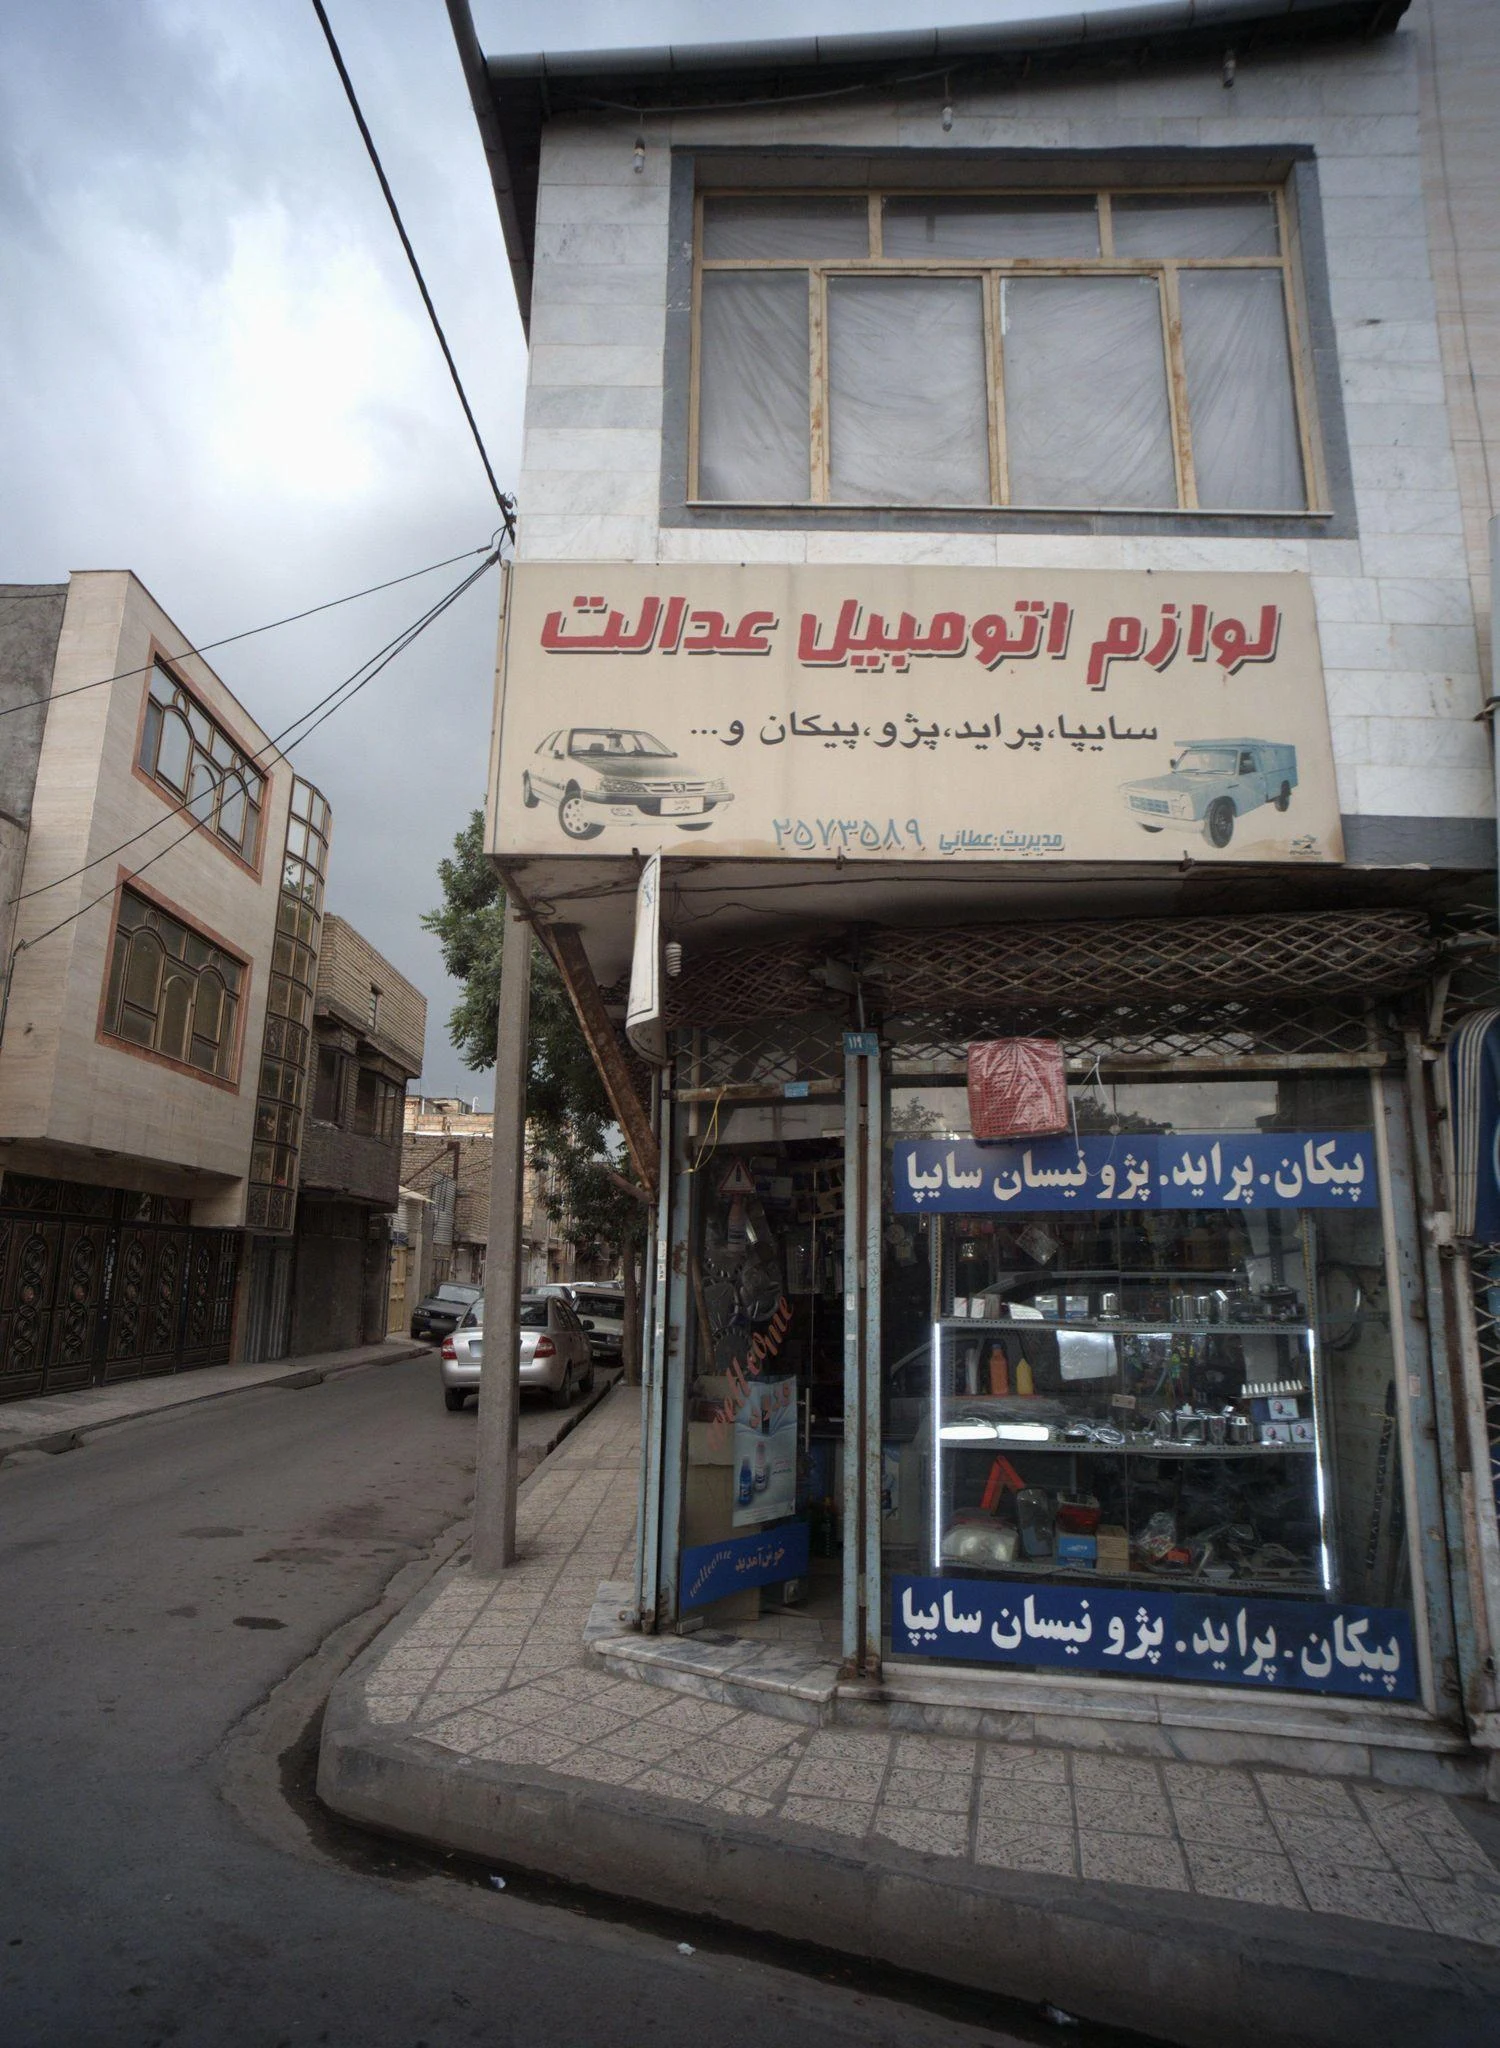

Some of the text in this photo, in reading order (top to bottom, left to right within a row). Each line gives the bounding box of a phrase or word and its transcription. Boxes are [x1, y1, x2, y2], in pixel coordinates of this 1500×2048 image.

[540, 595, 1282, 692] لوازم اتومبیل عدالت
[772, 818, 925, 851] ۲۵۷۳۵۸۹
[906, 1150, 983, 1204] سایپا
[993, 1149, 1089, 1201] نیسان
[1096, 1152, 1152, 1203] پژو
[902, 1586, 983, 1647] سایپا
[991, 1594, 1093, 1655] نیسان
[1102, 1606, 1165, 1665] پژو
